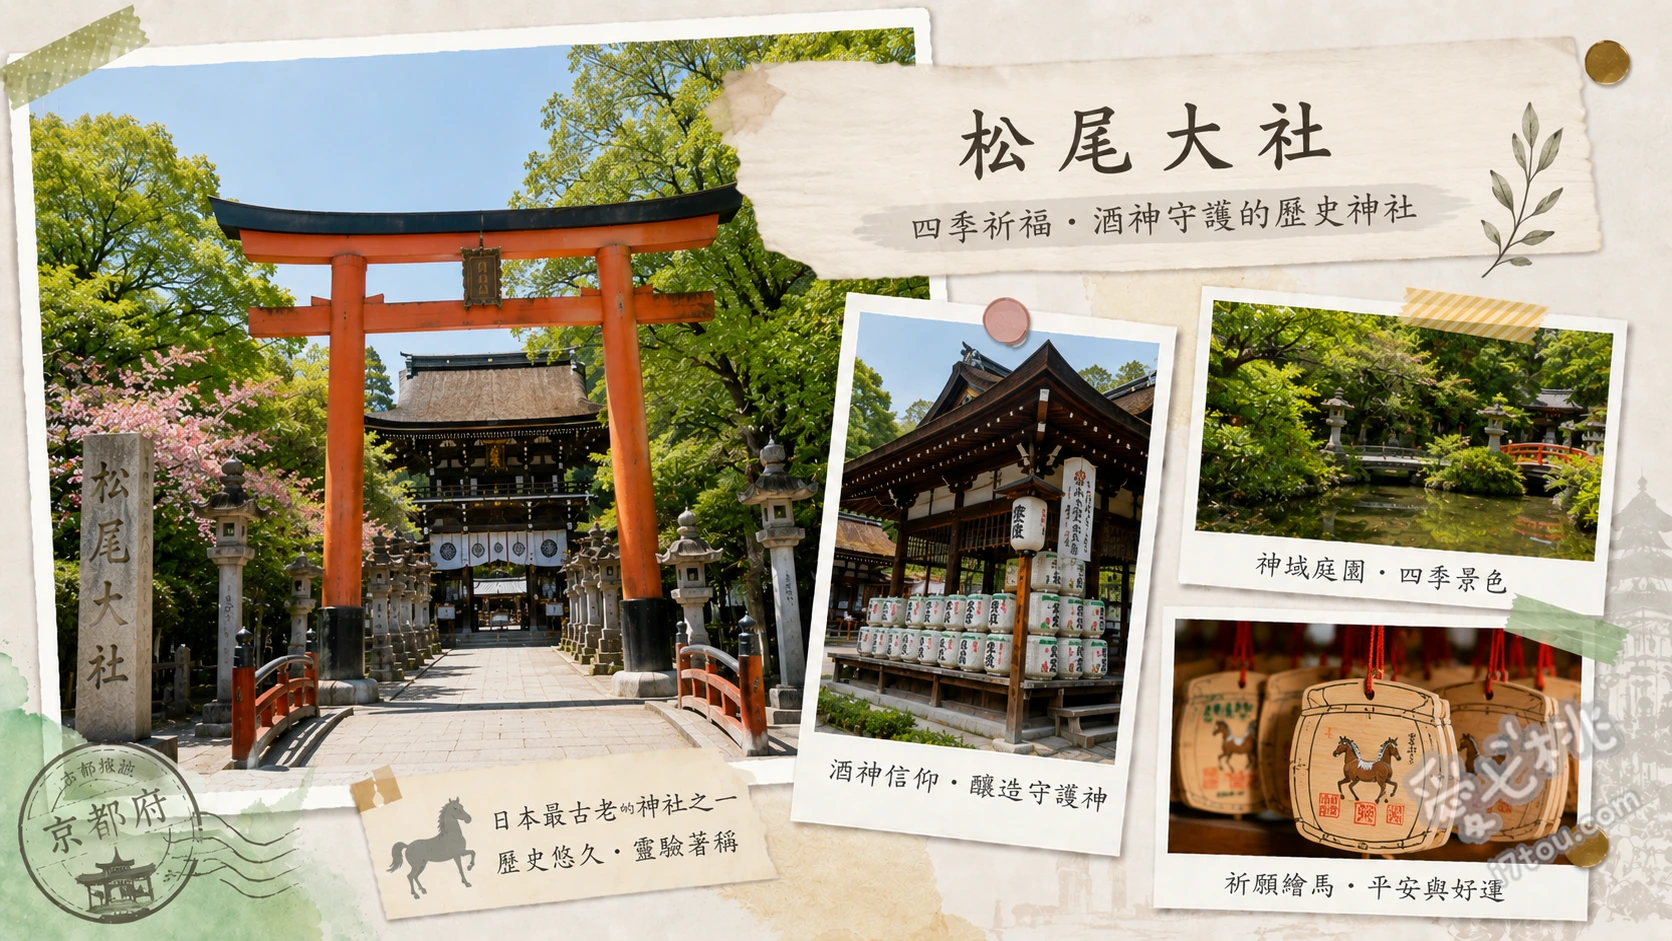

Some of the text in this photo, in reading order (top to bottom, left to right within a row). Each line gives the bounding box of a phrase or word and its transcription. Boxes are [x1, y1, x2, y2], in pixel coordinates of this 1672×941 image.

[959, 101, 1332, 181] 松尾大社
[86, 460, 131, 691] 松尾大社
[43, 787, 168, 854] 京都府
[494, 792, 738, 831] 日本最古老的神社之一
